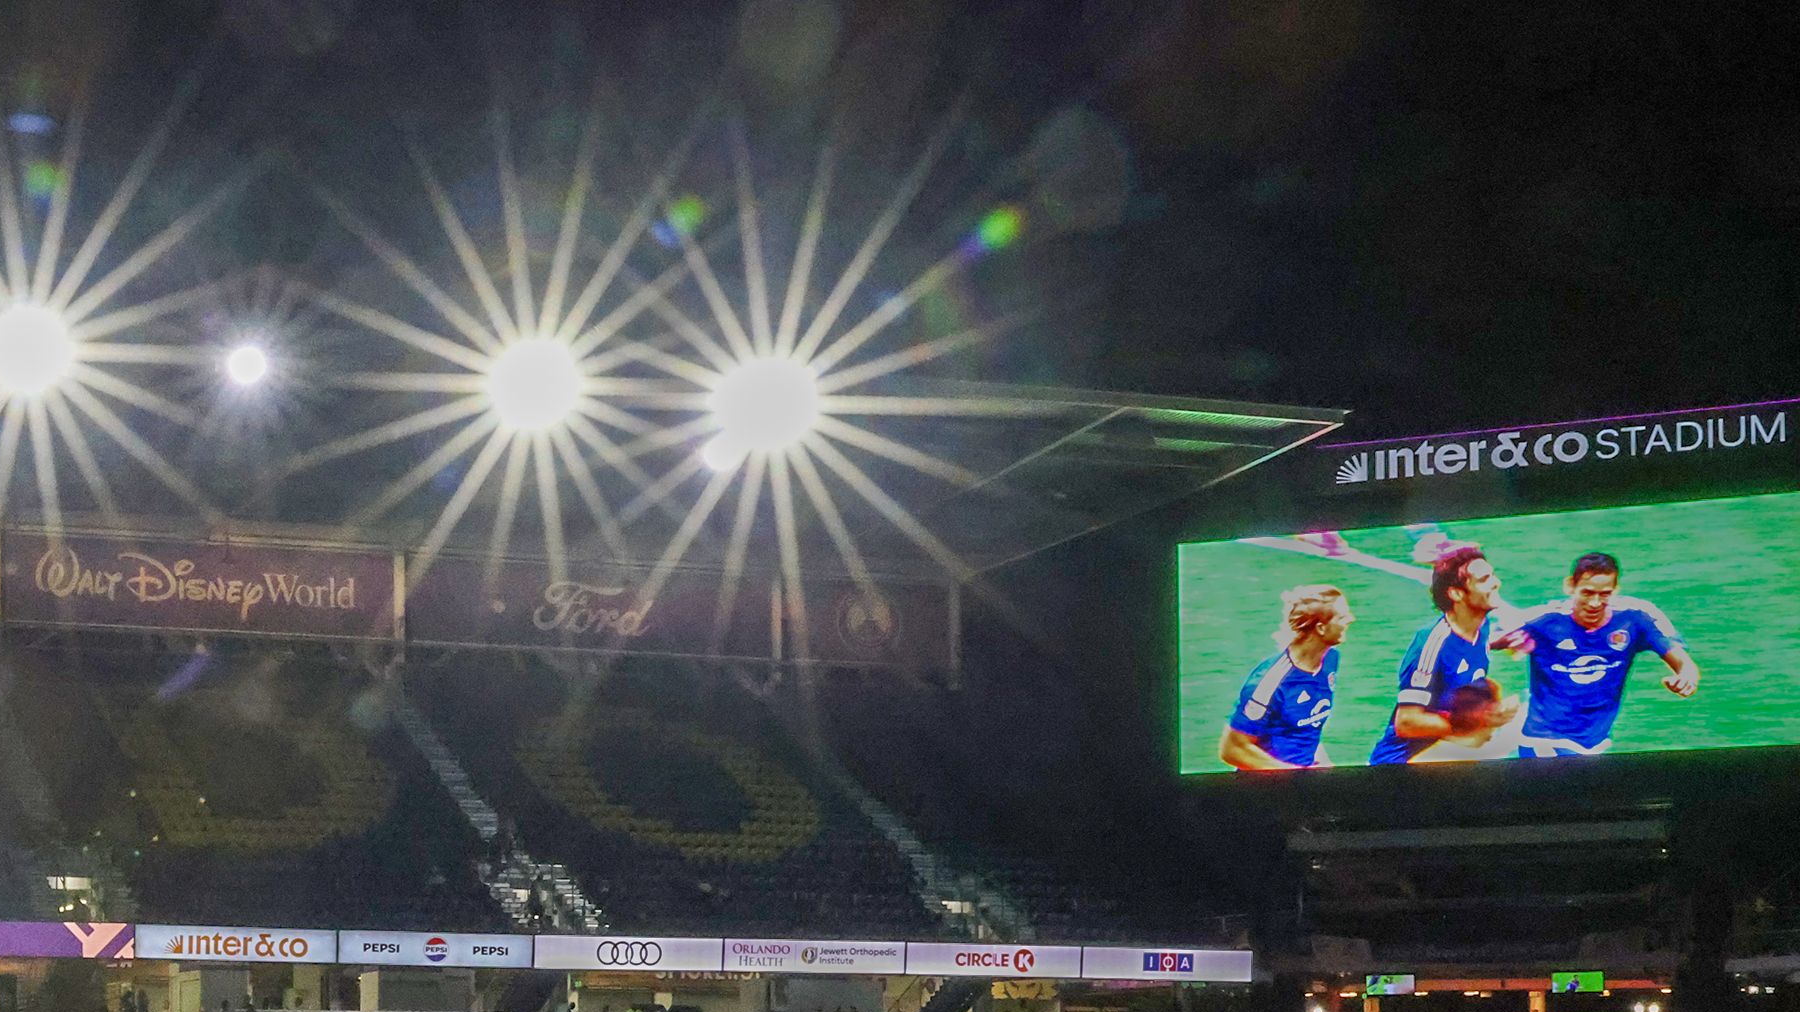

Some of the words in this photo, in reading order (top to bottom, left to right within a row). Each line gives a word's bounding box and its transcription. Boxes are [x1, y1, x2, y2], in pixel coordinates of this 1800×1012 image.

[1595, 412, 1787, 459] STADIUM
[262, 573, 356, 609] World
[533, 581, 651, 637] Ford
[363, 943, 400, 953] PEPSI
[472, 946, 509, 956] PEPSI
[732, 943, 791, 955] ORLANDO
[819, 947, 848, 956] Jewett
[850, 948, 897, 957] Orthopedic
[738, 955, 783, 967] HEALTH
[819, 957, 855, 965] Institute
[955, 952, 1010, 968] CIRCLE
